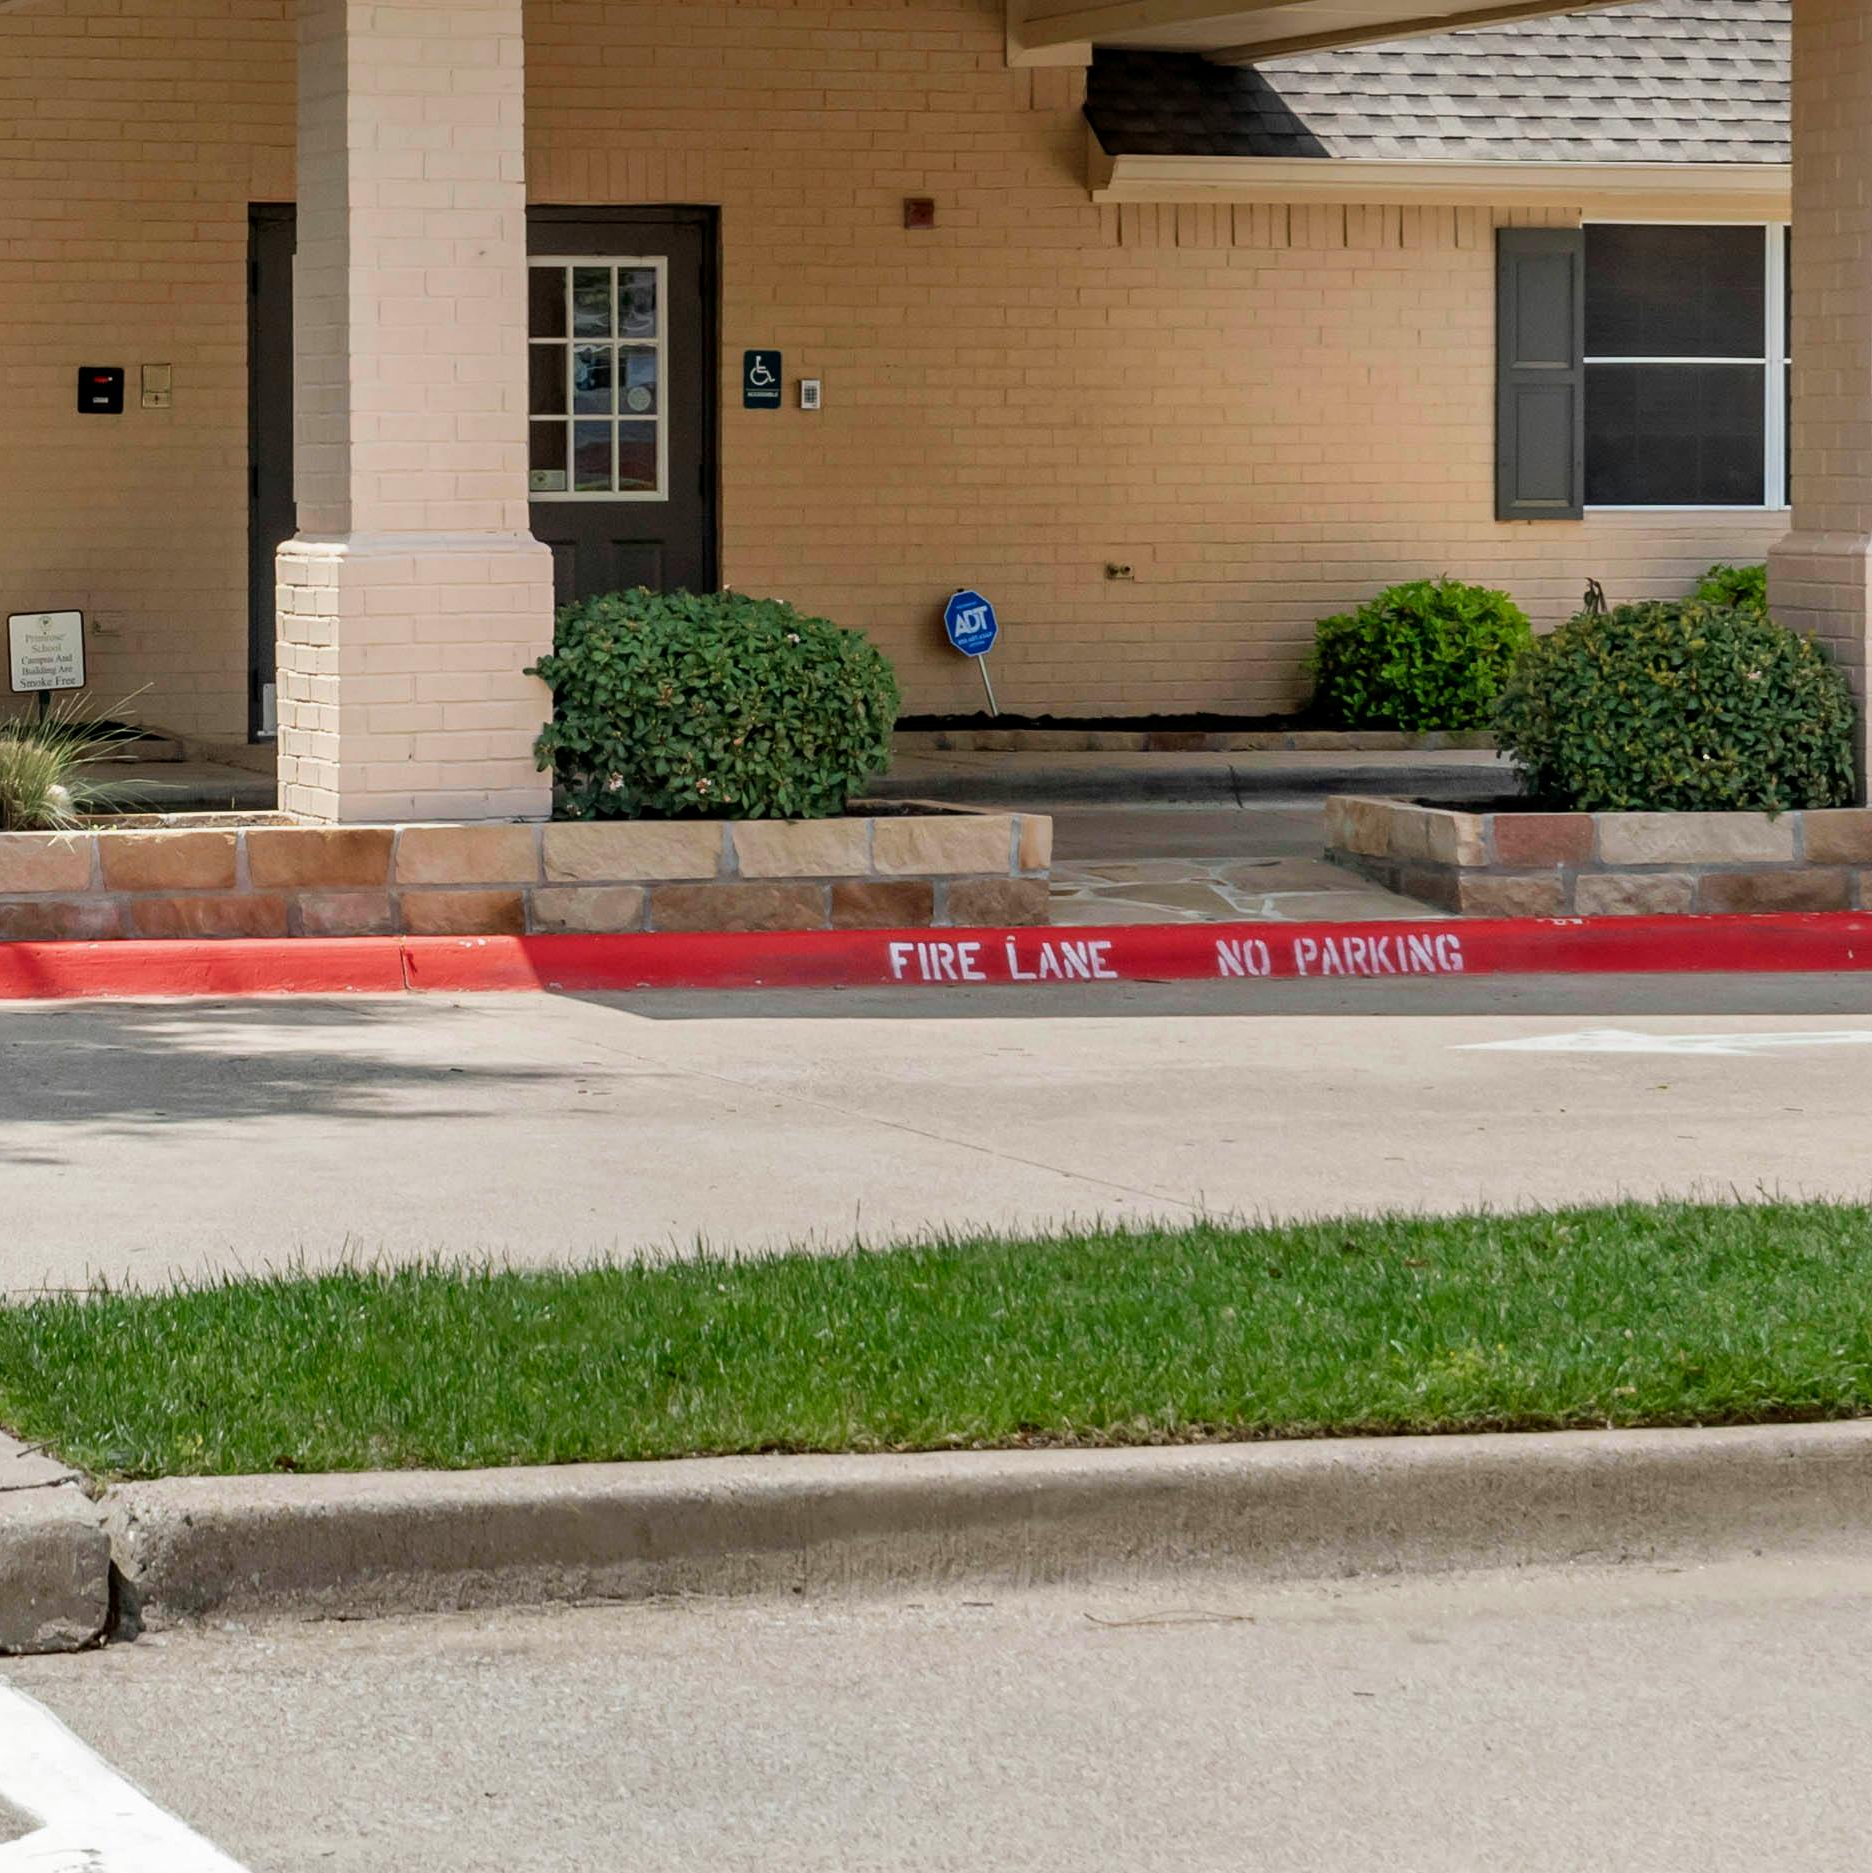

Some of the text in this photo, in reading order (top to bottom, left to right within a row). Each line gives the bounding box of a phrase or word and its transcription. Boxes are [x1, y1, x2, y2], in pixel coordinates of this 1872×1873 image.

[954, 605, 988, 638] ADT
[19, 675, 77, 689] Smoke Free
[889, 935, 1119, 980] FIRE LANE
[1216, 934, 1464, 976] NO PARKING
